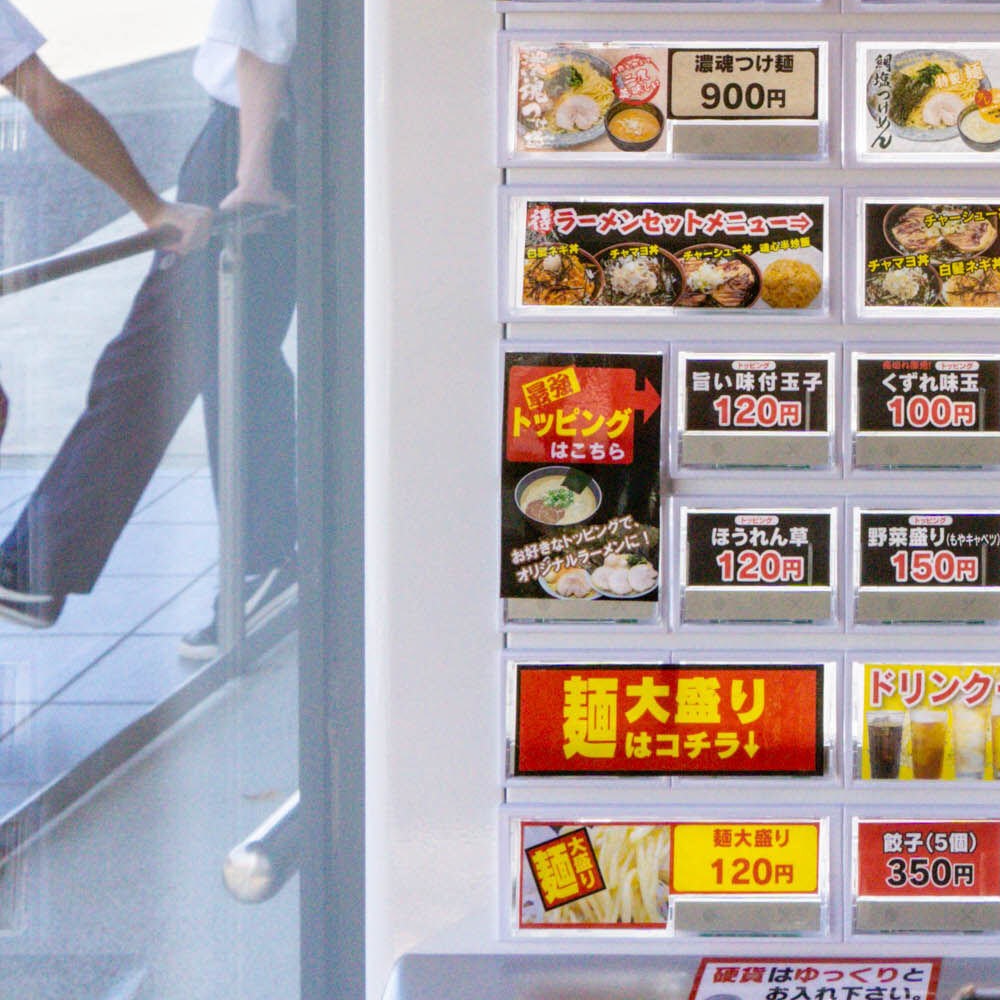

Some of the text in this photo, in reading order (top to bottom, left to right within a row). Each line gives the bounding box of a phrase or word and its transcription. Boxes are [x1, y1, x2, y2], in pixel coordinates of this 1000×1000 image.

[695, 54, 794, 73] 濃魂つけ麺
[700, 82, 787, 110] 900円
[554, 208, 790, 236] ラーメンセットメニュー
[683, 244, 753, 260] チャーシュー丼
[867, 254, 931, 273] チャマヨ丼
[525, 372, 574, 410] 最強
[692, 371, 823, 392] 旨い味付玉子
[881, 372, 980, 392] くずれ味玉
[512, 406, 633, 438] トッピング
[713, 394, 802, 428] 120円
[887, 394, 976, 428] 100円
[550, 441, 626, 461] はこちら
[711, 527, 809, 547] ほうれん草
[716, 549, 805, 583] 120円
[890, 550, 979, 583] 150円
[562, 675, 766, 760] 麺大盛り
[624, 731, 740, 759] はコチラ
[713, 829, 791, 848] 麺大盛り
[883, 832, 978, 854] 餃子(5個)
[531, 841, 580, 906] 麺
[710, 857, 794, 886] 120円
[885, 857, 975, 888] 350円
[713, 967, 925, 984] 硬貨はゆっくりと
